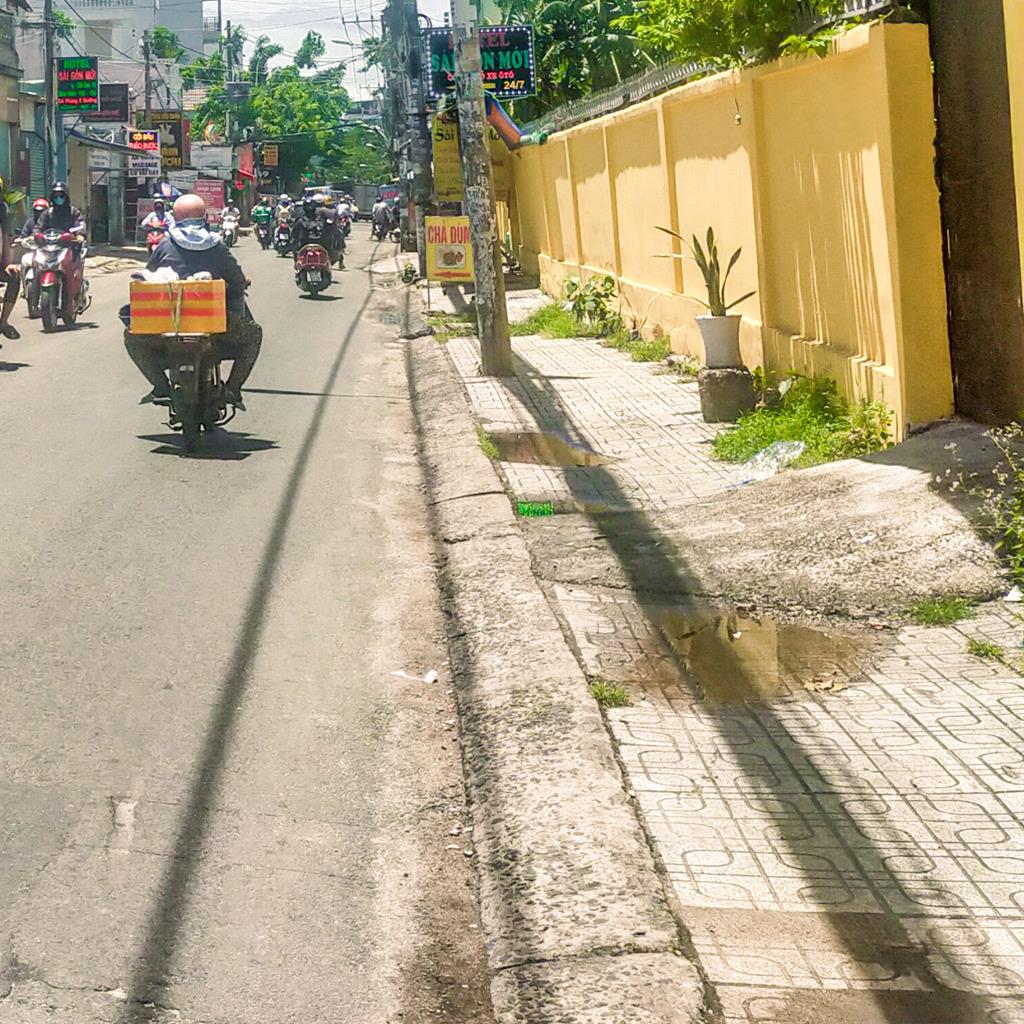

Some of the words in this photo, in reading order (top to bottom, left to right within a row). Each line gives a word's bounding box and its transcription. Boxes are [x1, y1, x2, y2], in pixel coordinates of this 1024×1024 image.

[498, 45, 529, 70] MỚI
[503, 79, 525, 90] 24/7
[434, 127, 455, 142] Sài
